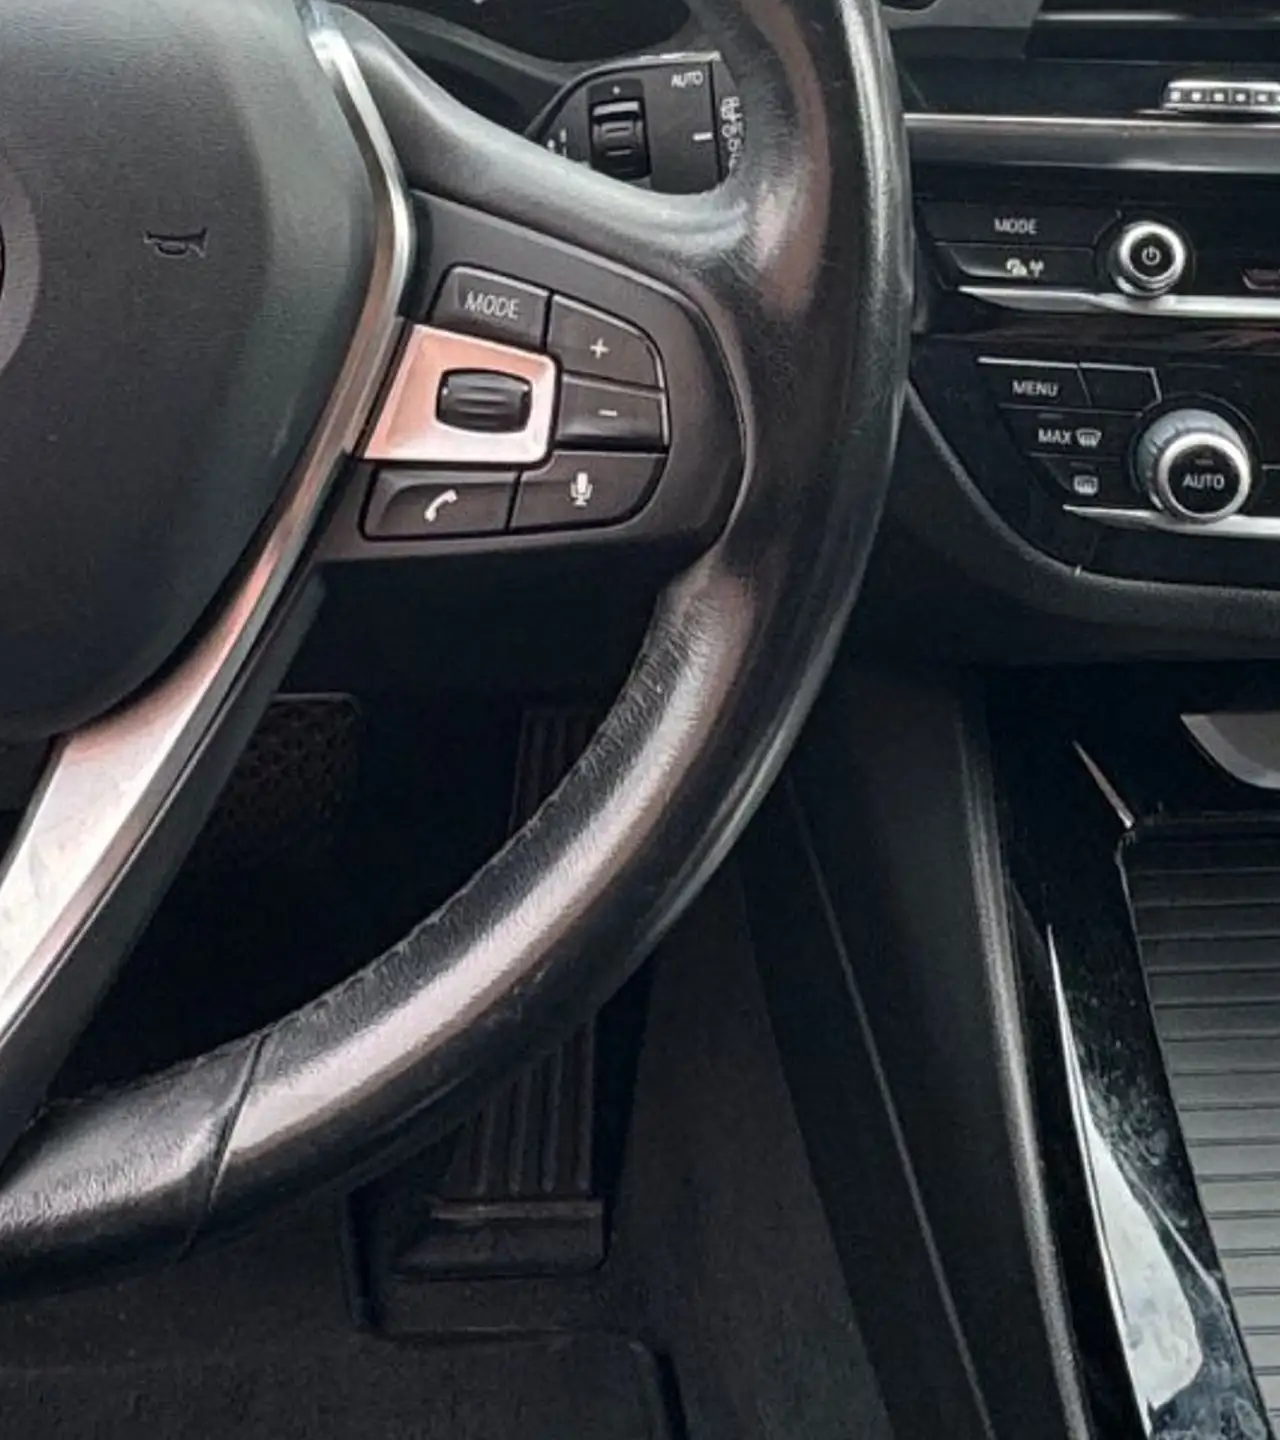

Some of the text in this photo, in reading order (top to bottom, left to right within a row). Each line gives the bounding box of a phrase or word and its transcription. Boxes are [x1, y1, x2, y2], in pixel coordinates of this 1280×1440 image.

[670, 70, 704, 88] AUTO
[994, 217, 1038, 236] MODE
[464, 290, 520, 320] MODE
[1011, 379, 1059, 398] MENU
[1038, 428, 1072, 445] MAX
[1182, 472, 1225, 491] AUTO
